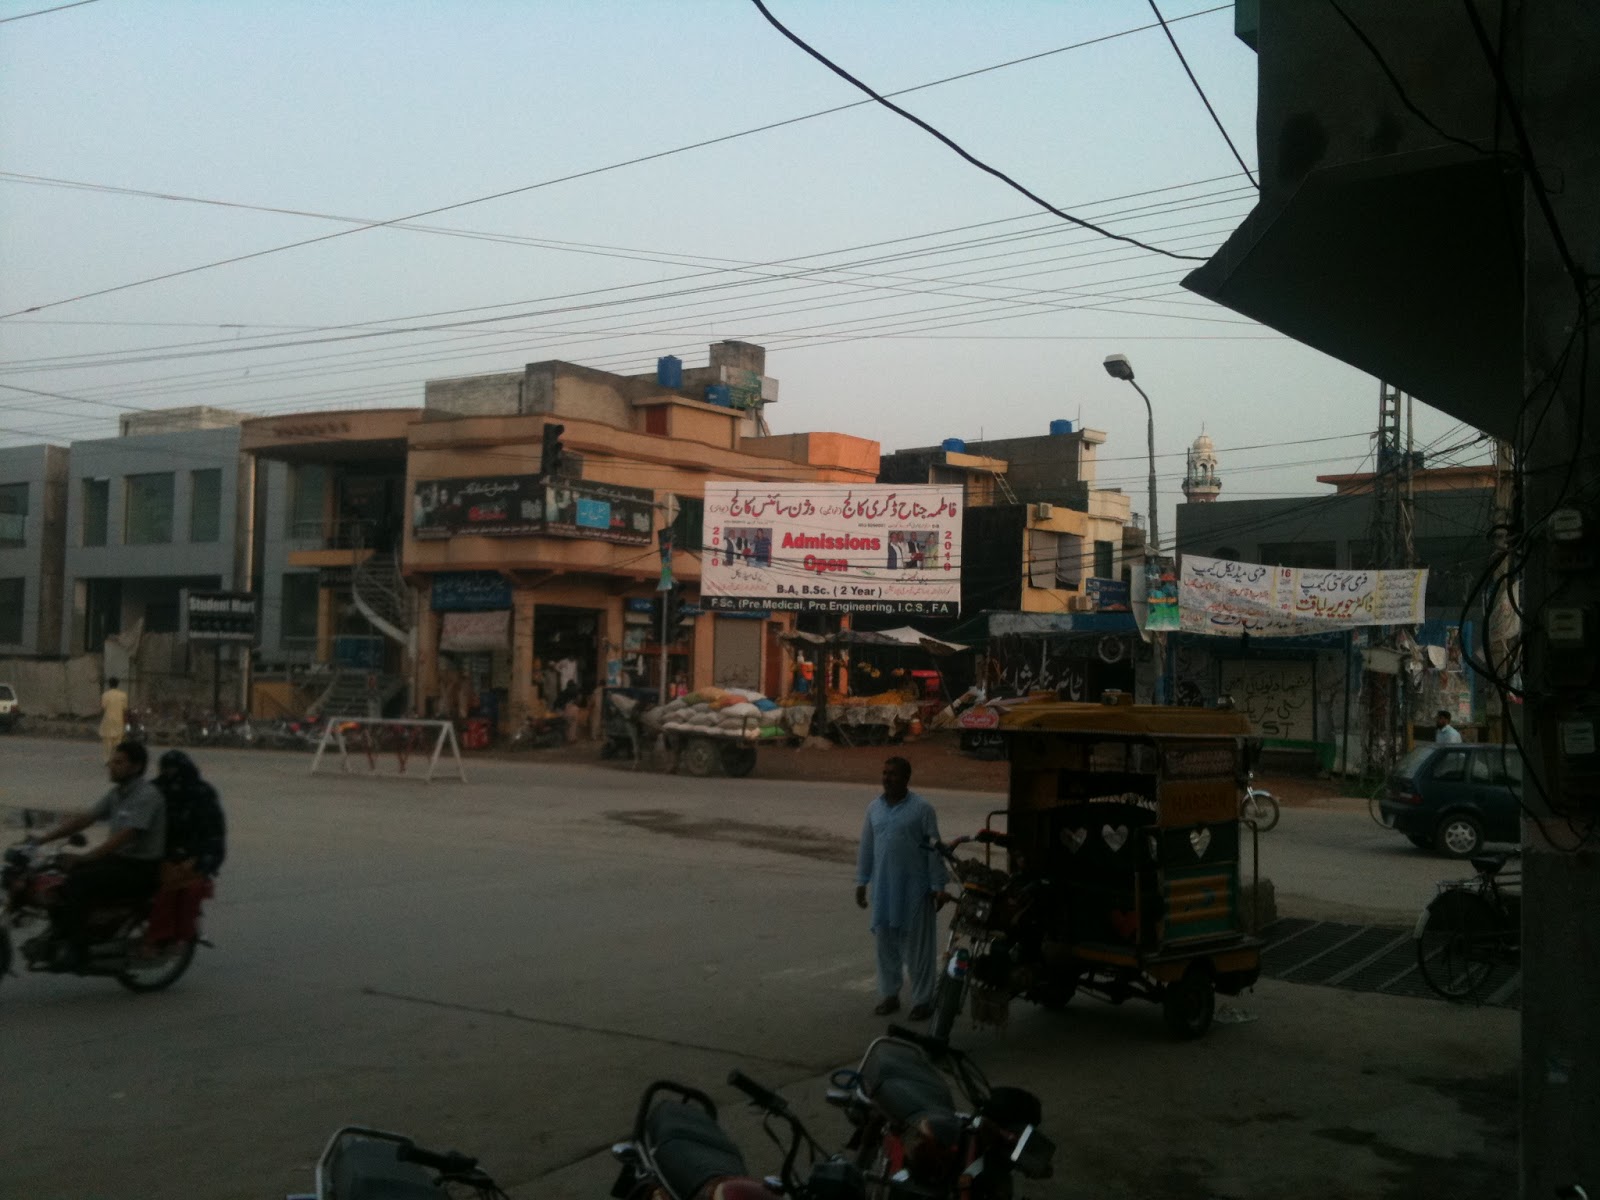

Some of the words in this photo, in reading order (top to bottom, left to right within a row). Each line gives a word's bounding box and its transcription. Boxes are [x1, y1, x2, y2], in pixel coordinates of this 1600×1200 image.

[730, 489, 755, 517] کالج
[752, 493, 788, 517] سائنس
[842, 490, 869, 520] کالج
[865, 493, 898, 519] ڈگری
[898, 502, 928, 520] جناح
[927, 497, 957, 518] فاطمہ
[781, 532, 881, 550] Admissions
[803, 554, 848, 575] Open
[1280, 568, 1291, 578] 16
[850, 585, 875, 597] Year
[1262, 721, 1294, 739] ST
